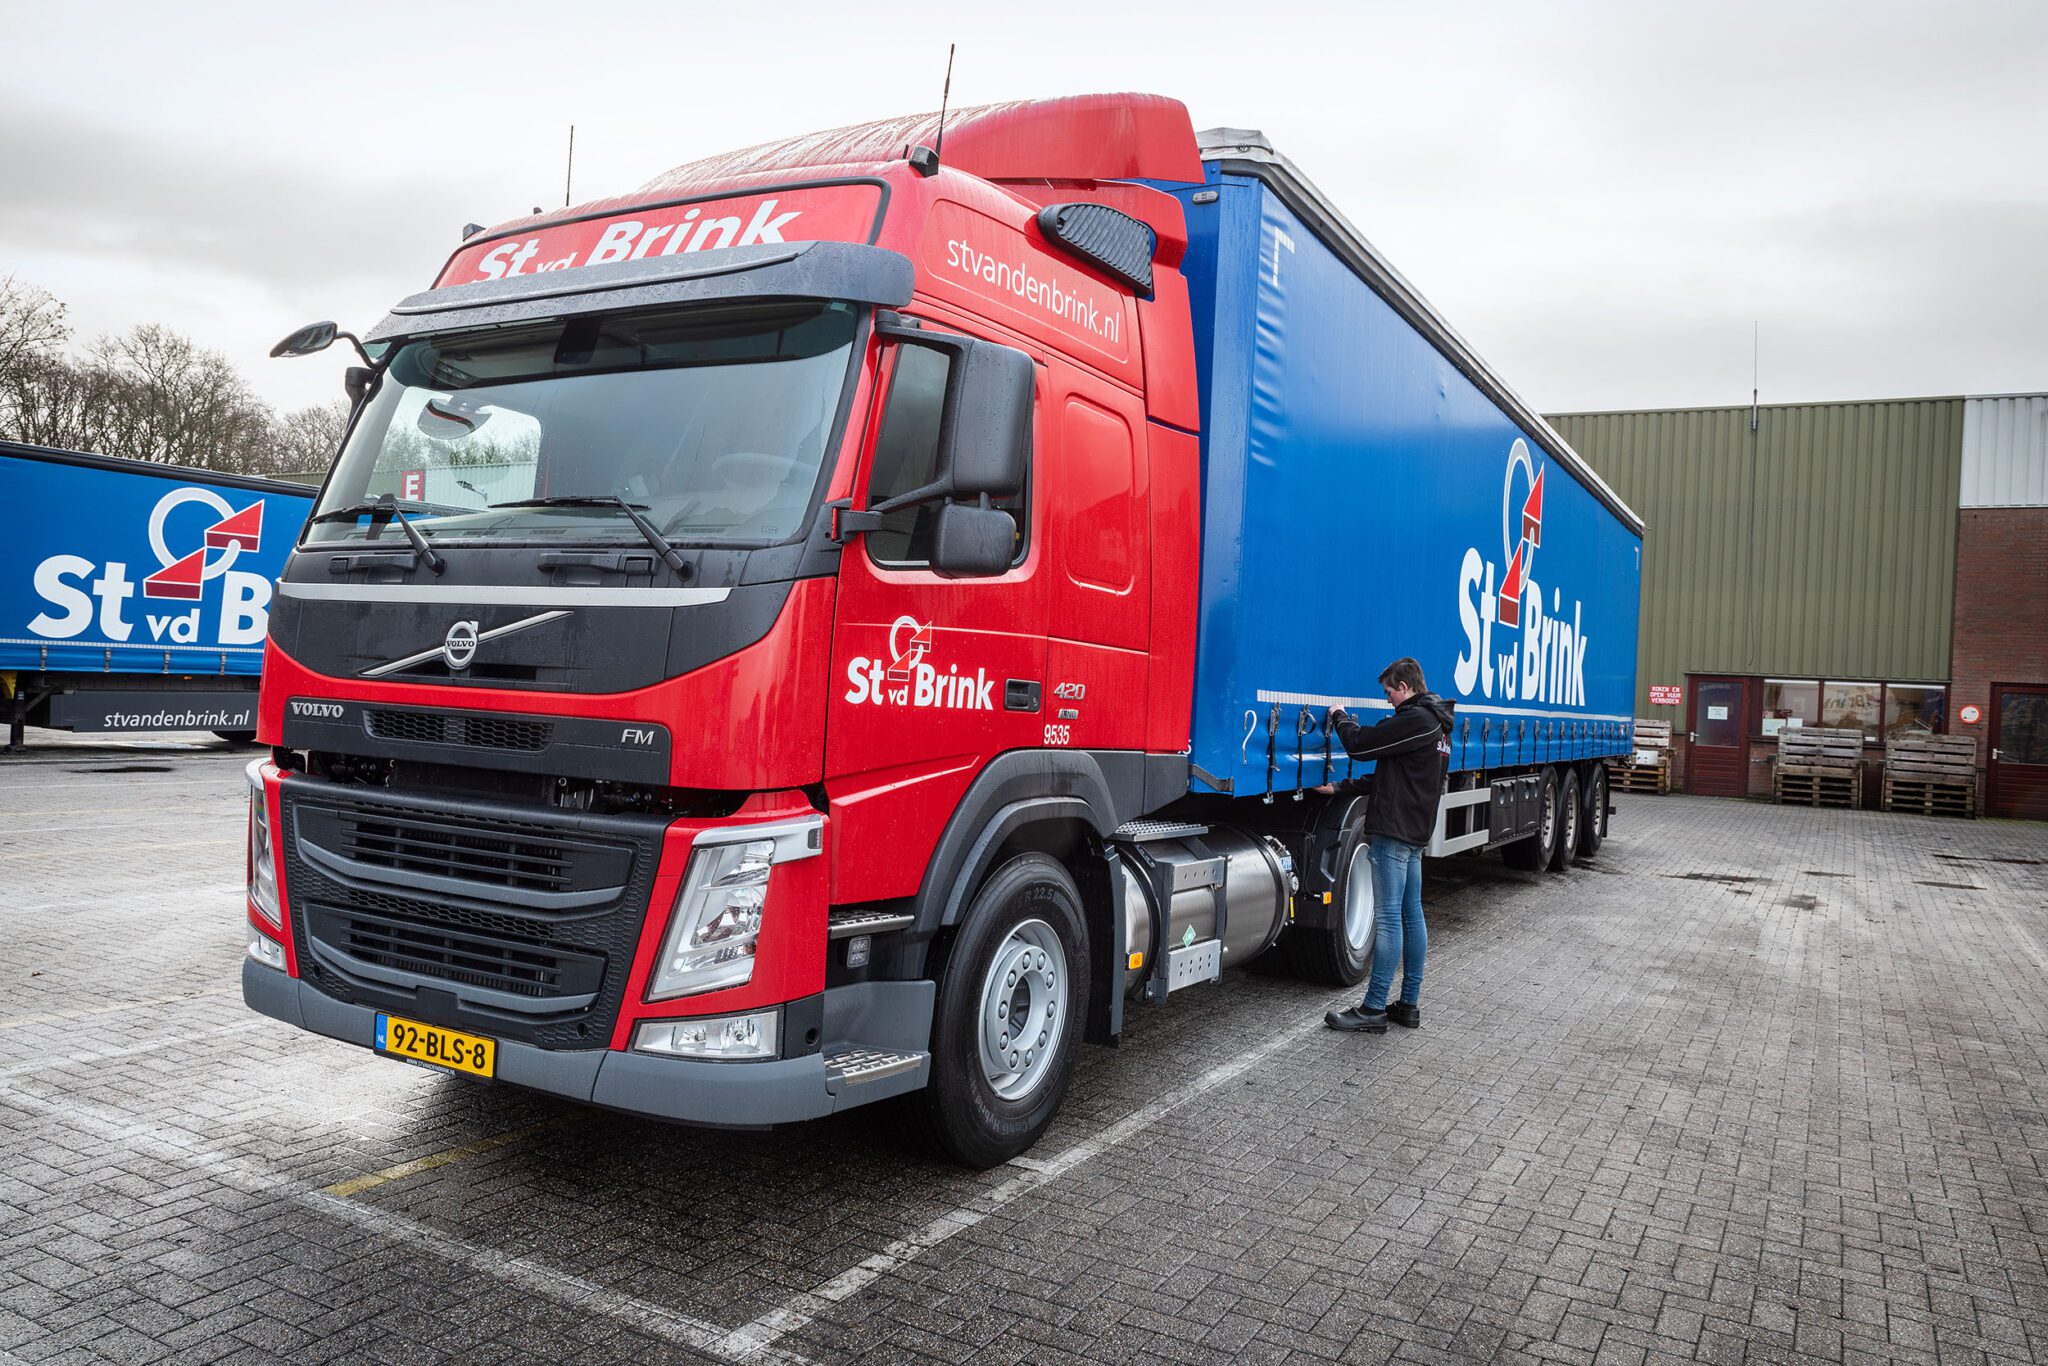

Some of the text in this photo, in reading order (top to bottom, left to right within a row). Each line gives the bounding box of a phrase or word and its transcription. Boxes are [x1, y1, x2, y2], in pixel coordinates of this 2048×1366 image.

[470, 238, 541, 284] St
[584, 199, 804, 267] Brink
[947, 239, 1120, 344] stvandenbrink.nl
[406, 474, 420, 502] E
[26, 554, 135, 642] St
[146, 608, 200, 643] vd
[1454, 547, 1588, 707] St vd Brink
[446, 640, 475, 648] VOLVO
[844, 656, 996, 711] St vd Brink
[1053, 682, 1086, 700] 420
[104, 710, 250, 728] stvandenbrink.nl
[291, 702, 344, 718] VOLVO
[621, 728, 655, 745] FM
[1044, 724, 1070, 745] 9535
[377, 1034, 386, 1044] NL
[393, 1023, 486, 1069] 92-BLS-8
